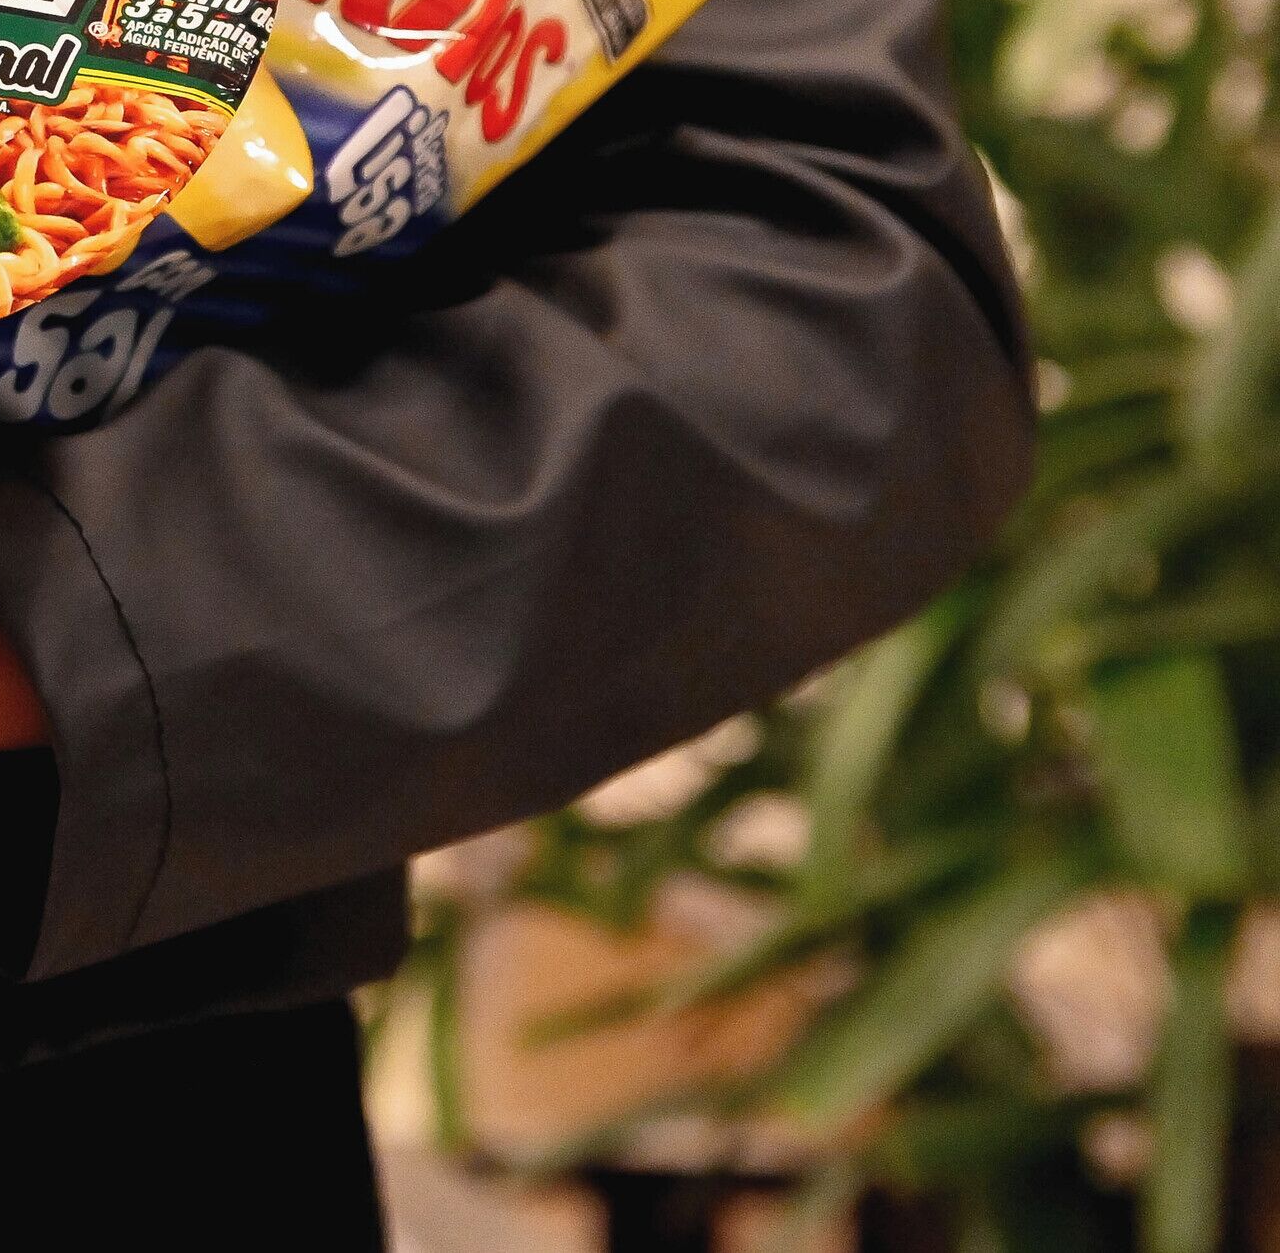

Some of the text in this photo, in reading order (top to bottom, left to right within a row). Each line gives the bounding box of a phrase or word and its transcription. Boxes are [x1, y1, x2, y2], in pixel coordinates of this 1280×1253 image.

[152, 7, 174, 24] a
[176, 3, 210, 30] 5
[123, 30, 161, 49] ÁGUA
[164, 26, 176, 39] A
[178, 31, 230, 54] ADIÇÃO
[232, 46, 249, 65] DE
